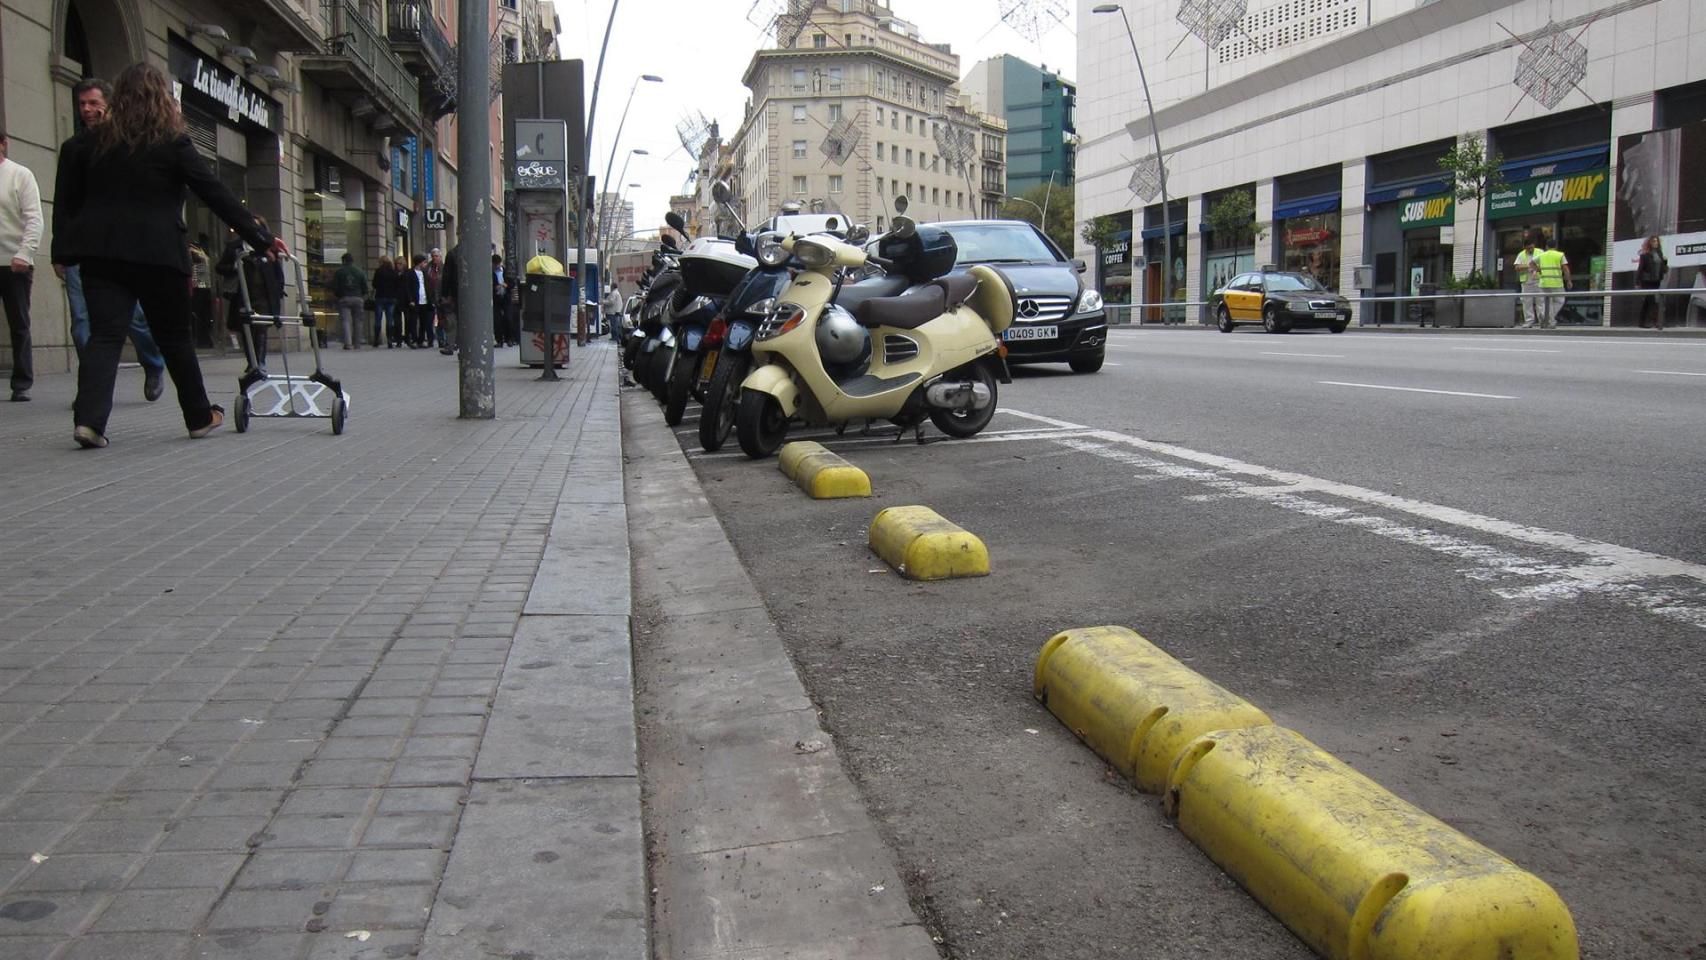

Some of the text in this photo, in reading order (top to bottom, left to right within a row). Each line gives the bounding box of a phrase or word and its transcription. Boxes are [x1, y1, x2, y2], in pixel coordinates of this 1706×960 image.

[193, 58, 209, 94] La
[210, 68, 240, 123] tienda
[239, 87, 248, 116] de
[1530, 173, 1604, 207] SUBWAY
[1400, 196, 1452, 223] SUBWAY
[1105, 253, 1123, 264] COFFEE
[1009, 327, 1056, 339] 0409 GKW
